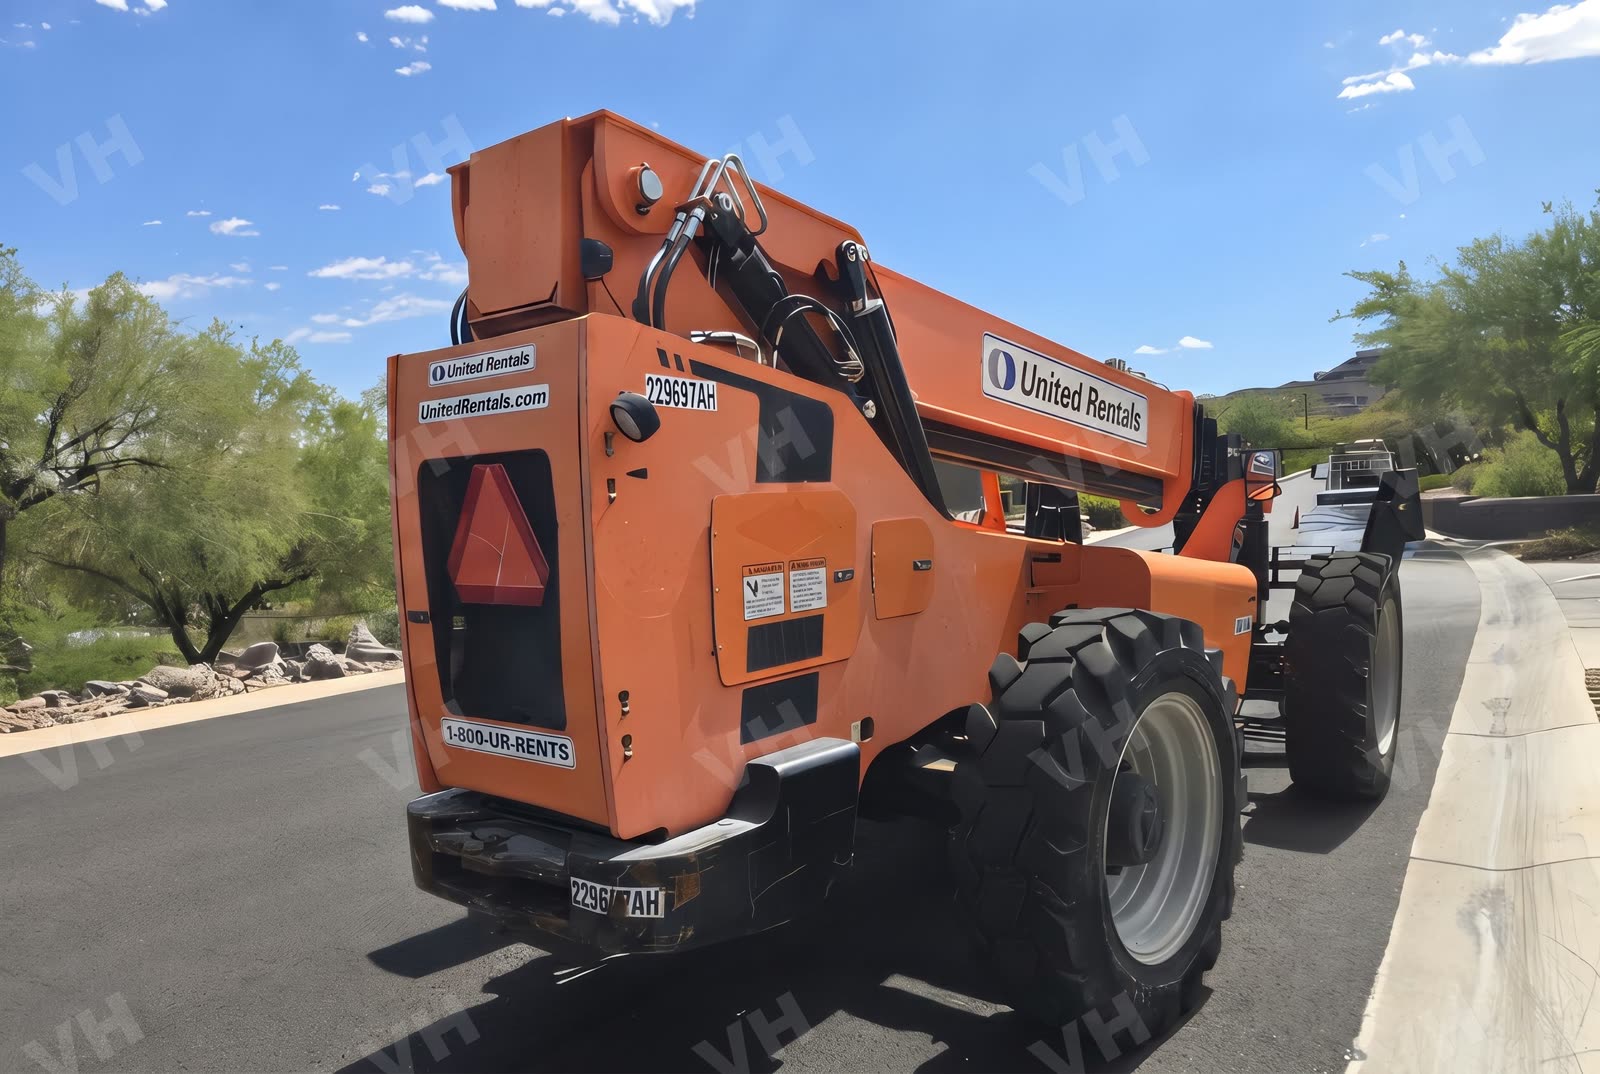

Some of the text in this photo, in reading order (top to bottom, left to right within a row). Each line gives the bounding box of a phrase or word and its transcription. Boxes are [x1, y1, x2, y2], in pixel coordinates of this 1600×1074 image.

[447, 351, 530, 378] United Rentals
[420, 391, 546, 420] UnitedRentals.com
[646, 376, 716, 410] 229697AH
[1020, 360, 1141, 432] United Rentals
[446, 725, 569, 760] 1-800-UR-RENTS
[572, 880, 659, 915] 22967AH
